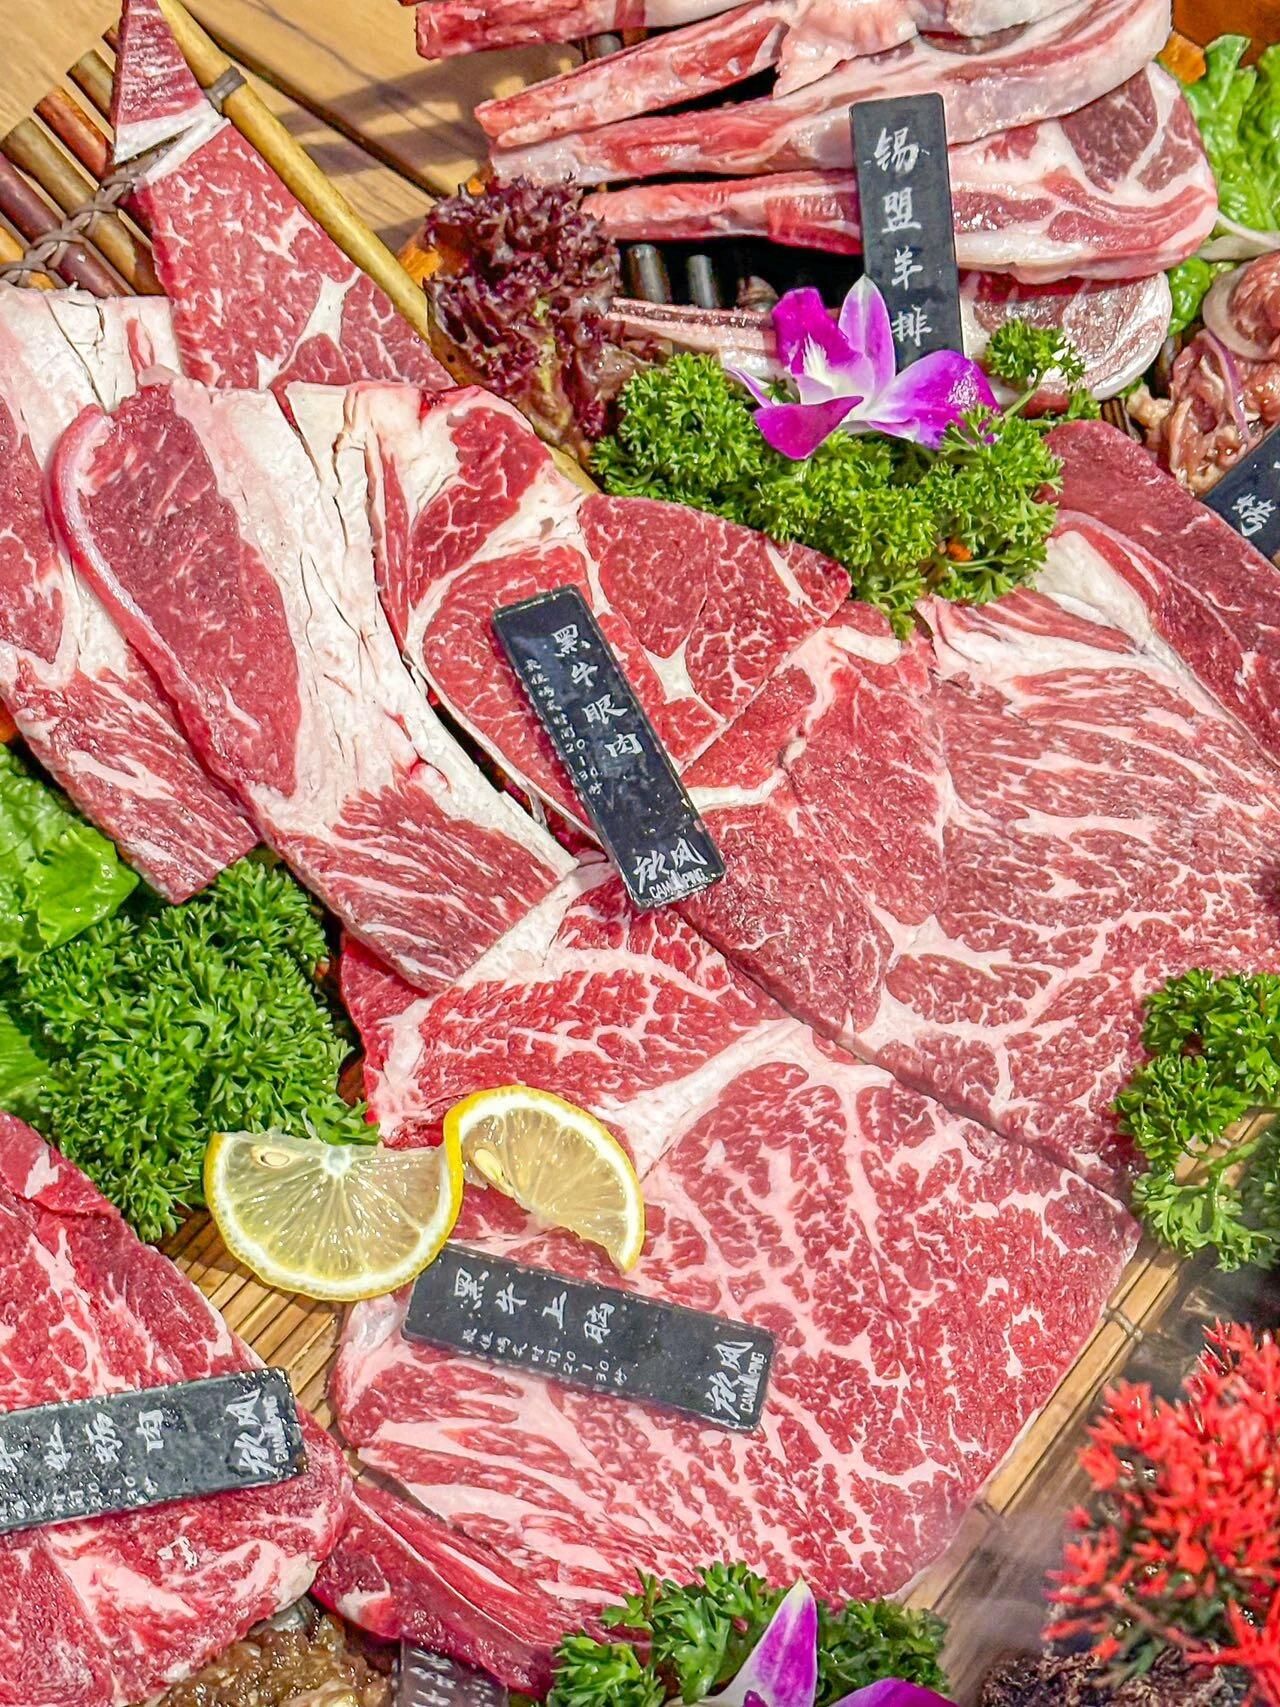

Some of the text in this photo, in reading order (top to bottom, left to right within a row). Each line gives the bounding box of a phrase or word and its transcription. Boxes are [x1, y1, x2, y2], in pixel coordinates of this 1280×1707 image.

[874, 127, 932, 347] 锡盟羊排
[551, 623, 644, 758] 黑牛眼肉
[453, 1268, 616, 1343] 黑牛上脑
